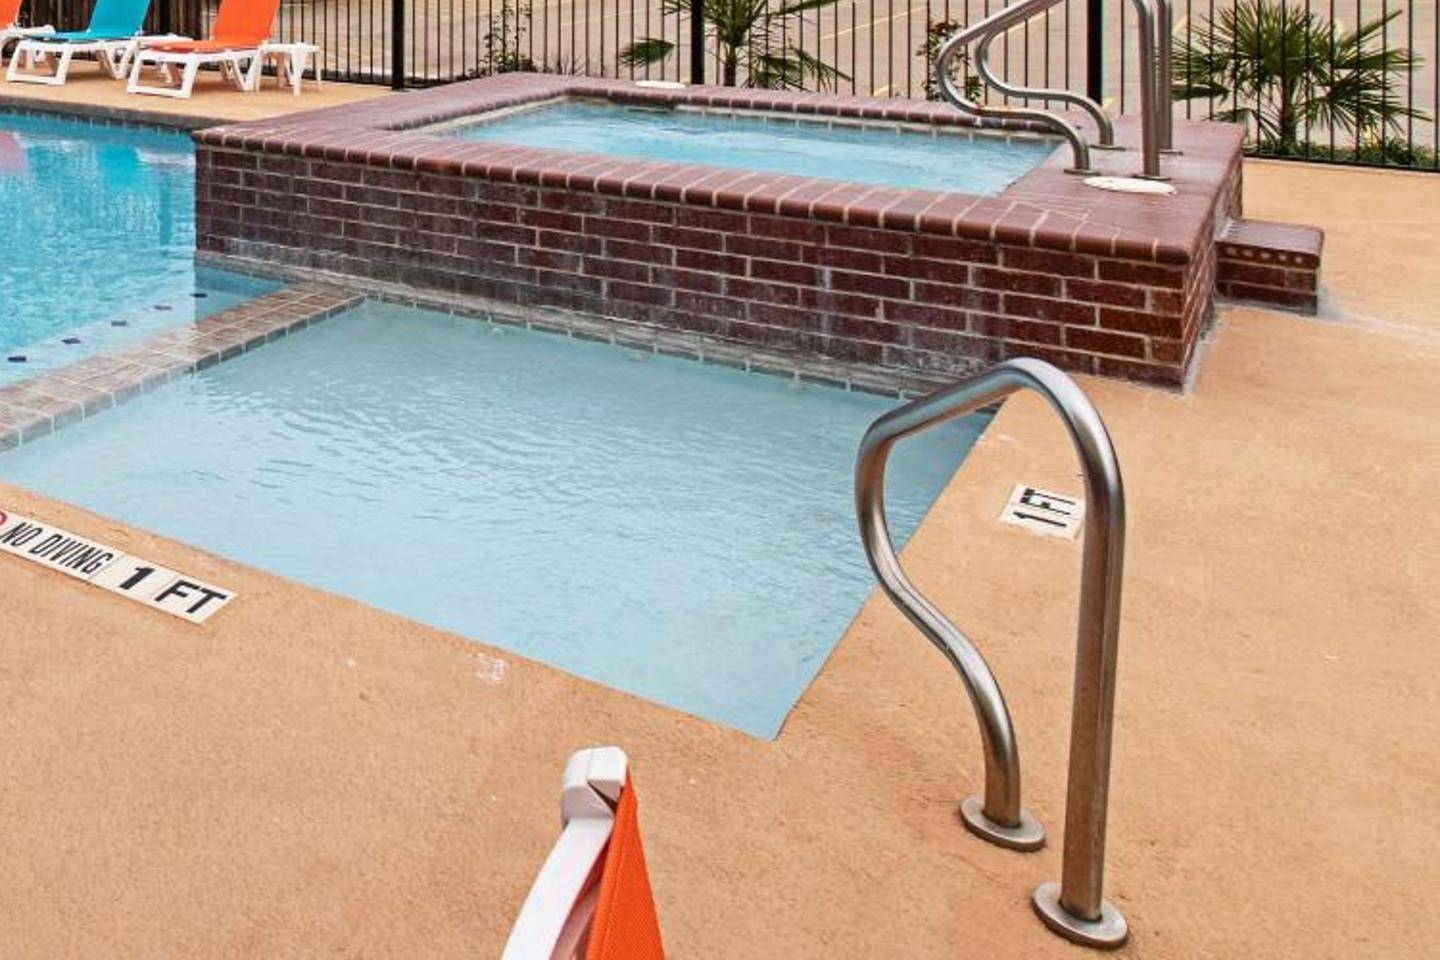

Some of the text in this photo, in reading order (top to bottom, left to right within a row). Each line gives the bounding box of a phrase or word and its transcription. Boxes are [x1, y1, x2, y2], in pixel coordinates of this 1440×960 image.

[1012, 488, 1077, 528] 1 FT
[27, 533, 114, 575] DIVING
[118, 565, 155, 590] 1
[154, 579, 228, 614] FT
